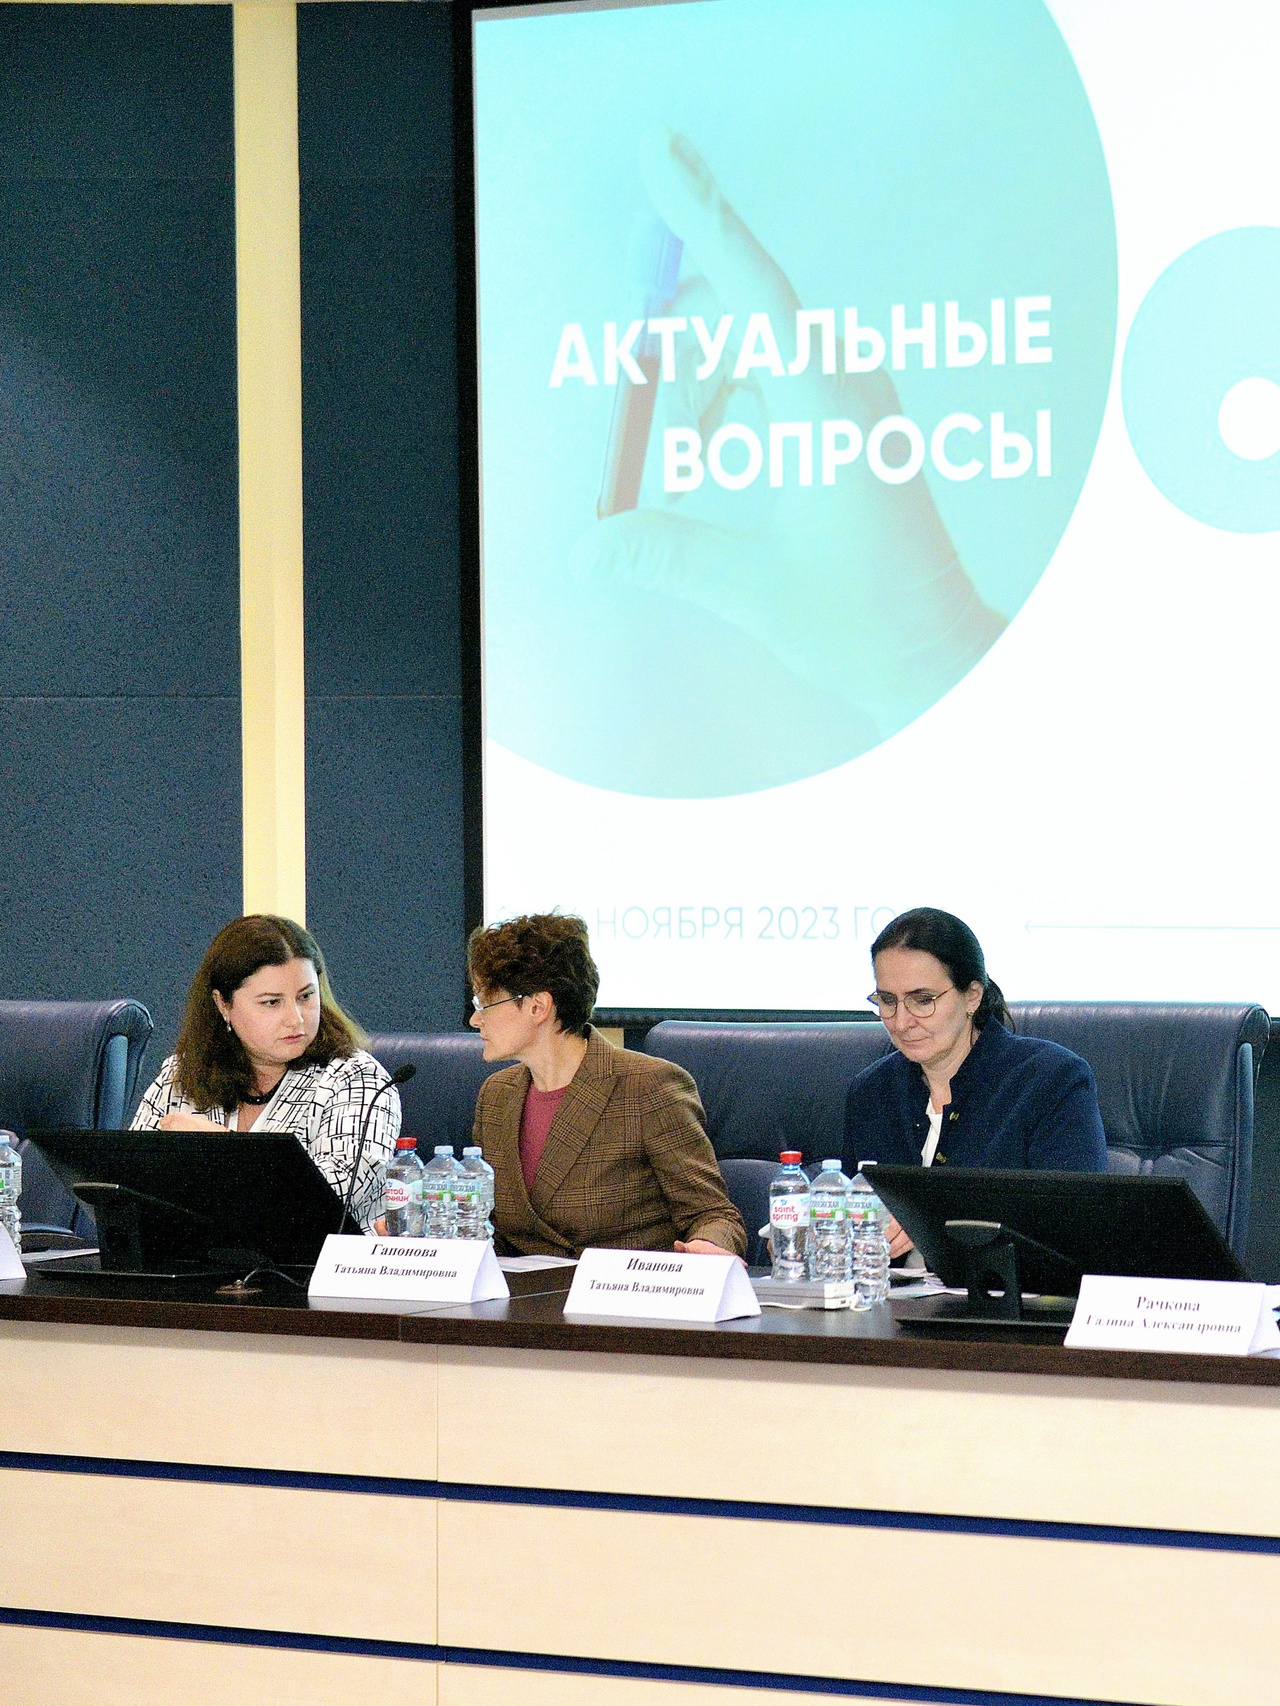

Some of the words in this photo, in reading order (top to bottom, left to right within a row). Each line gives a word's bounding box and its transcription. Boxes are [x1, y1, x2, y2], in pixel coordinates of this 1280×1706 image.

[548, 295, 1053, 388] АКТУАЛЬНЫЕ
[662, 409, 1053, 493] ВОПРОСЫ
[595, 904, 745, 941] НОЯБРЯ
[756, 904, 841, 941] 2023
[370, 1243, 438, 1258] Гапонова
[334, 1264, 377, 1275] Татьяна
[379, 1265, 458, 1279] Владимировна
[626, 1258, 684, 1273] Иванова
[590, 1280, 630, 1291] Татьяна
[631, 1282, 704, 1297] Владимировна
[1136, 1296, 1201, 1312] Рачкова
[1086, 1315, 1135, 1328] Галина
[1140, 1318, 1242, 1334] Александровна
